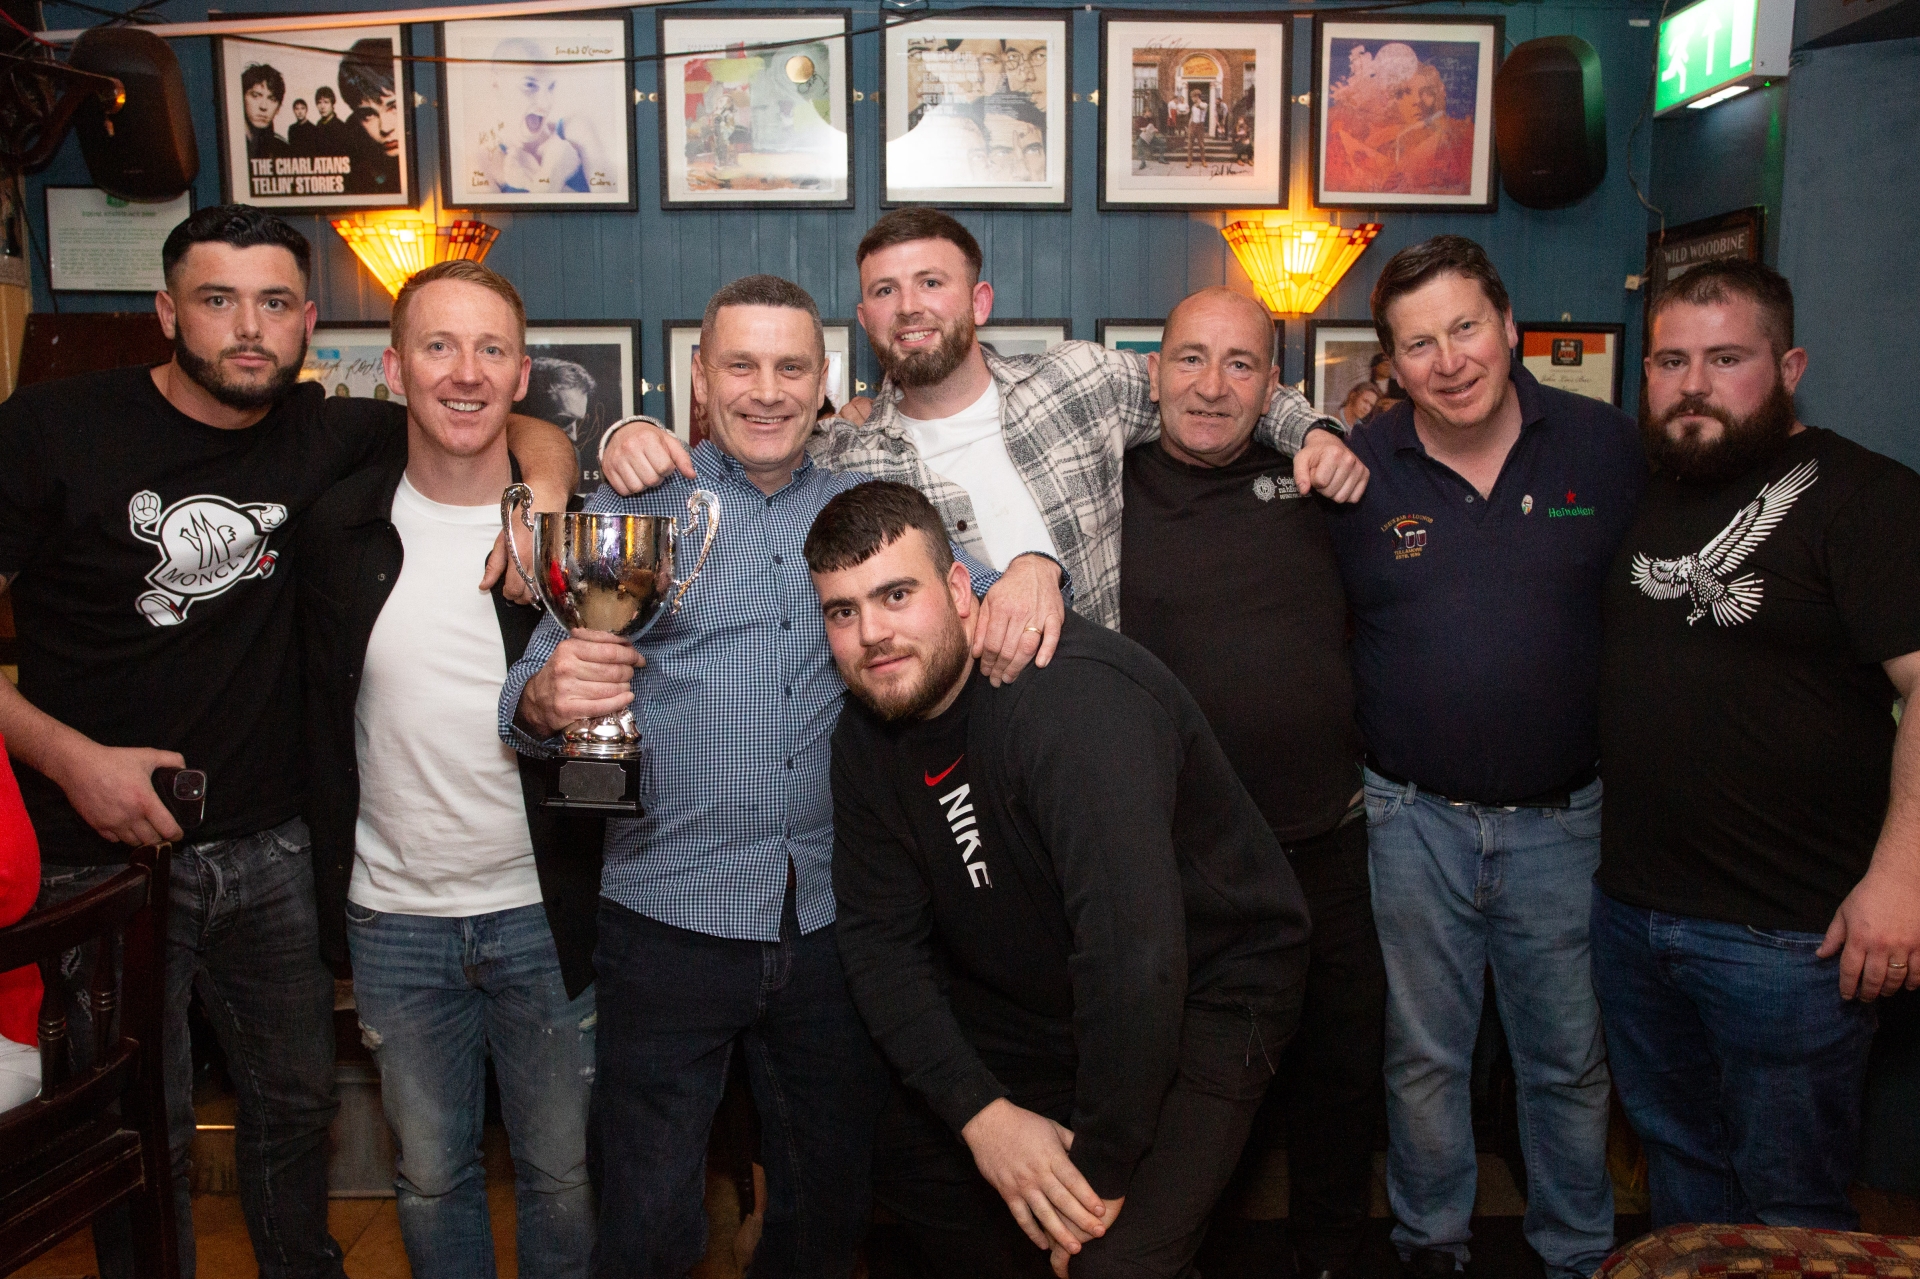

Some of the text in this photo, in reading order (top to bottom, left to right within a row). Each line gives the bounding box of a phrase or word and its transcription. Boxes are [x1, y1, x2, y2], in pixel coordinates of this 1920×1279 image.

[251, 156, 351, 176] THE CHARLATANS
[252, 175, 345, 194] TELLIN' STORIES
[1665, 233, 1745, 264] WILD WOODBINE
[1548, 506, 1595, 518] Heineken
[938, 783, 992, 889] NIKE
